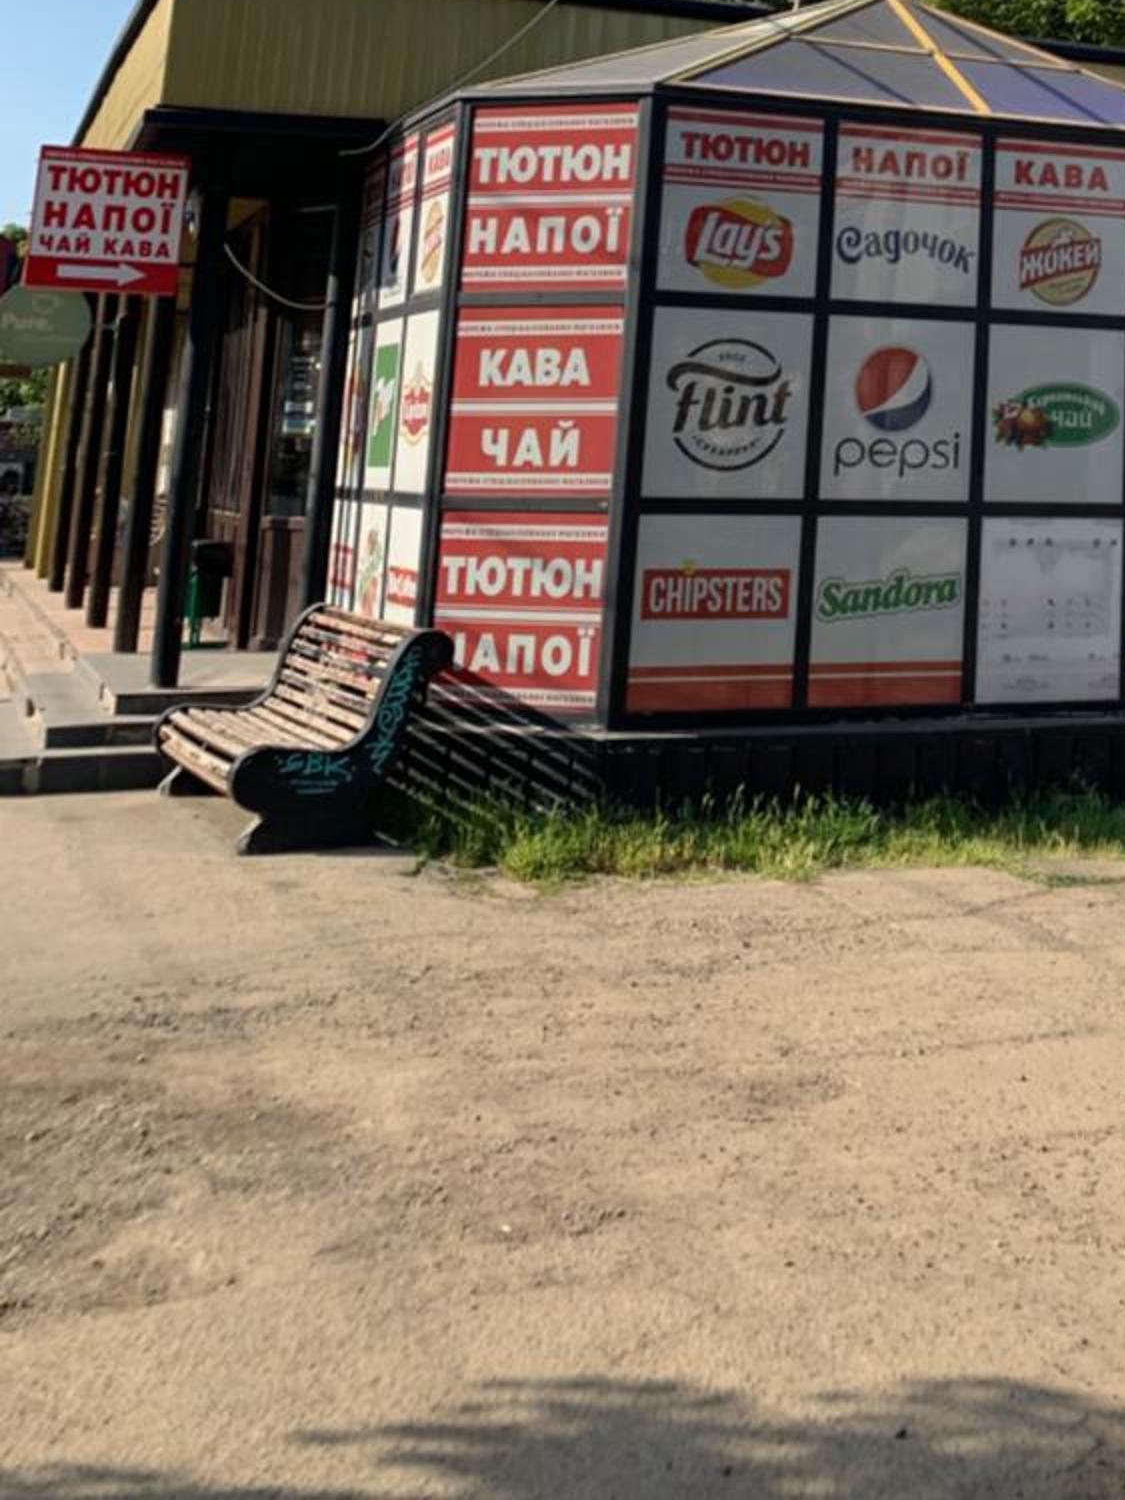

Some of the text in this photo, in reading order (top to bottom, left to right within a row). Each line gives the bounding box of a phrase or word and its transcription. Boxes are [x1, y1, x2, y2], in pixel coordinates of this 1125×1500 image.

[474, 144, 632, 184] ТЮТЮН
[680, 132, 811, 167] ТЮТЮН
[853, 147, 969, 181] НАПОЇ
[47, 165, 181, 199] ТЮТЮН
[1014, 160, 1108, 191] КАВА
[43, 201, 175, 235] НАПОЇ
[468, 207, 624, 255] НАПОЇ
[39, 233, 171, 258] ЧАЙ КАВА
[478, 347, 592, 387] КАВА
[480, 420, 581, 467] ЧАЙ
[833, 431, 960, 478] pepsi
[442, 555, 603, 599] ТЮТЮН
[650, 576, 783, 613] CHIPSTERS
[818, 575, 958, 617] Sandora
